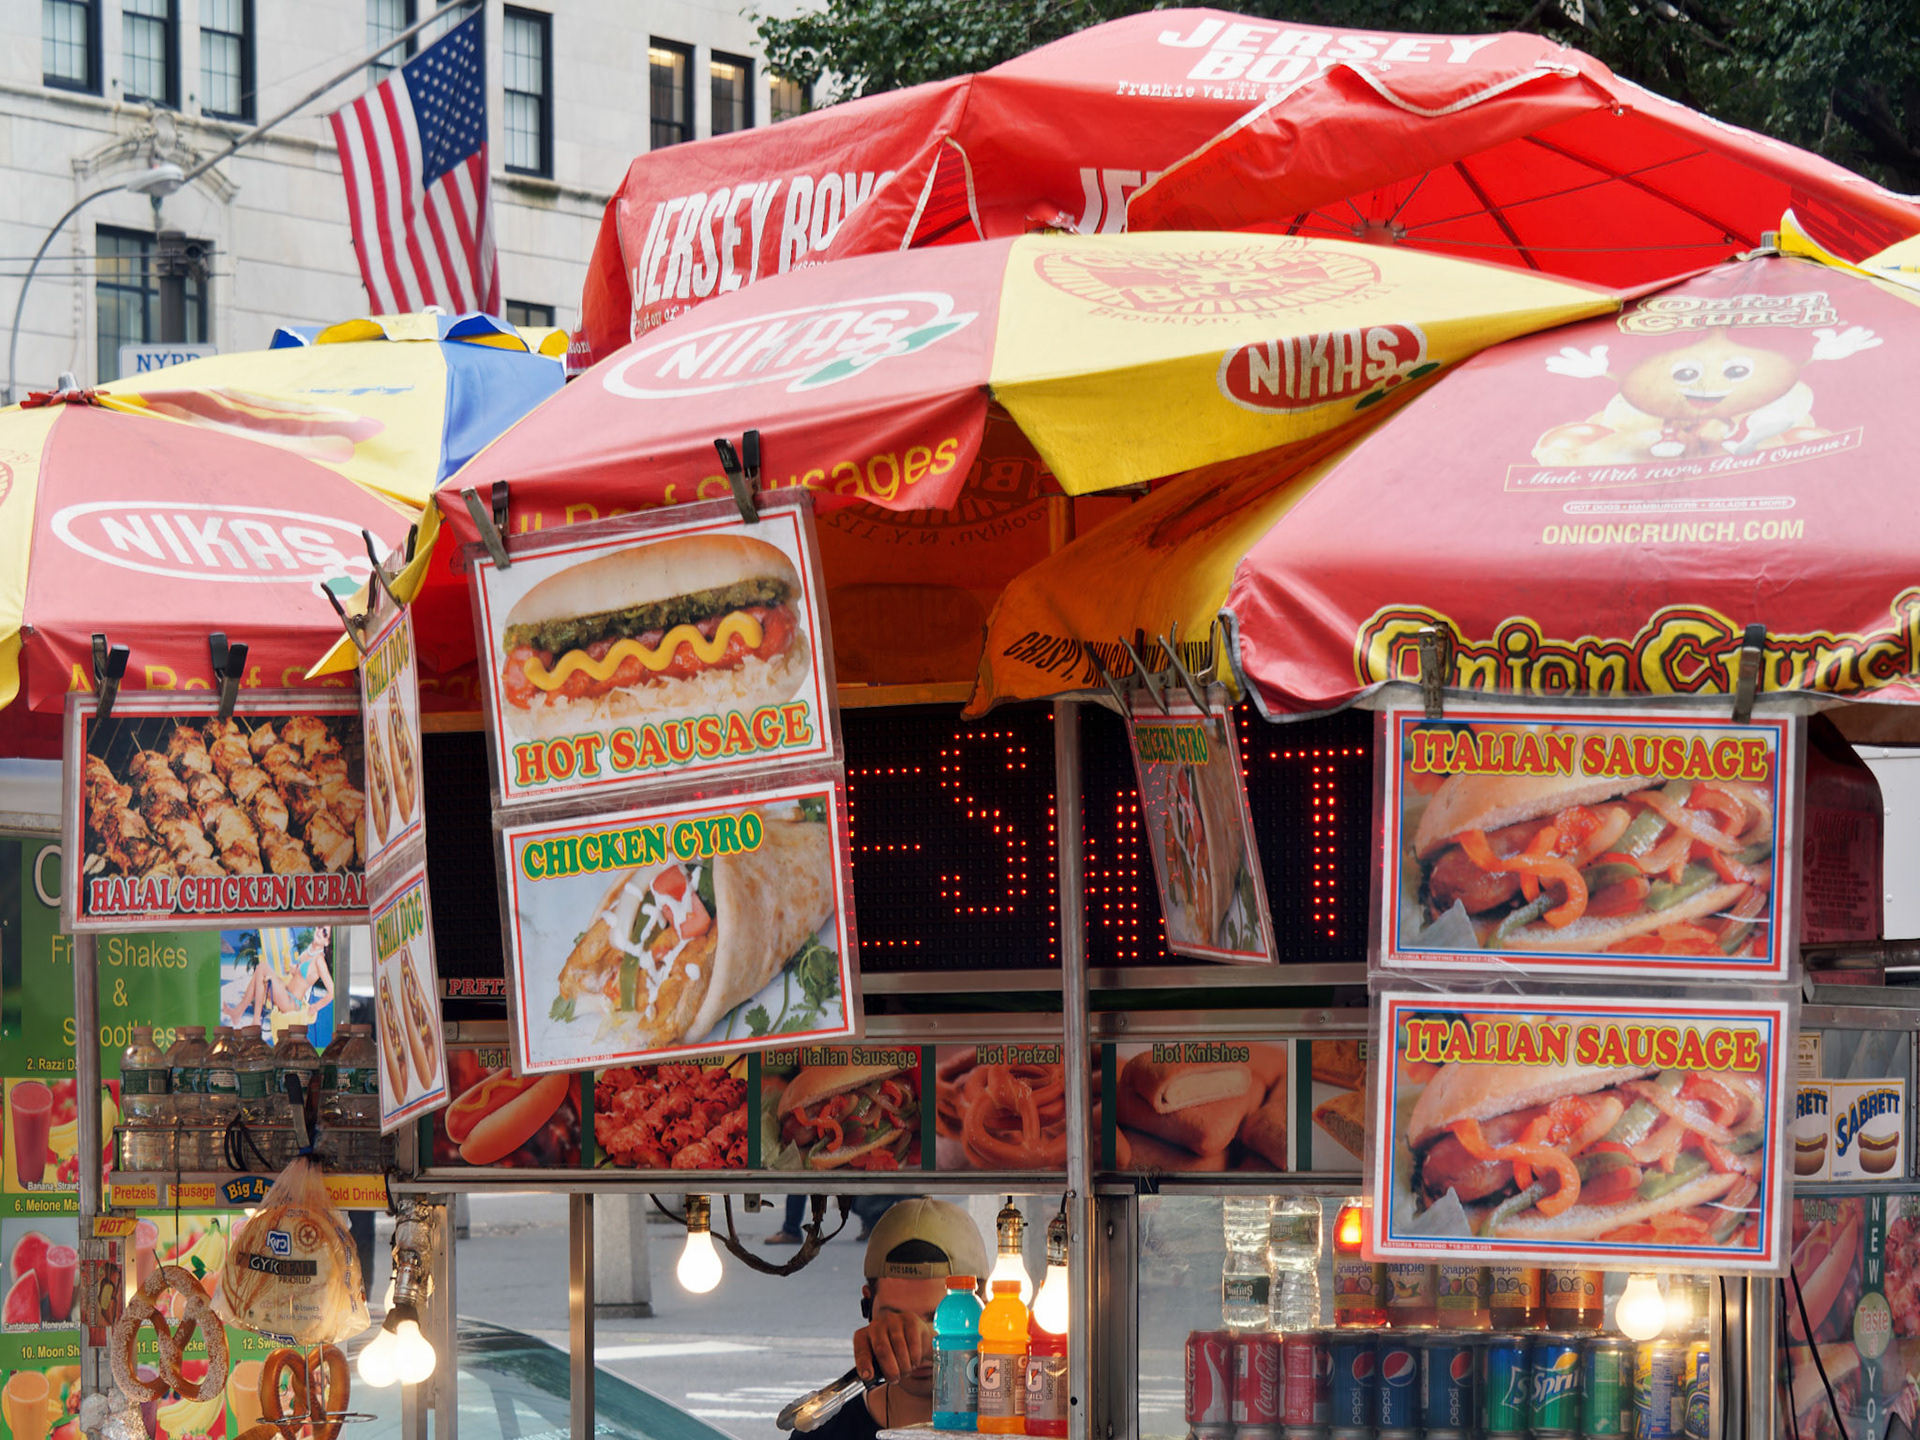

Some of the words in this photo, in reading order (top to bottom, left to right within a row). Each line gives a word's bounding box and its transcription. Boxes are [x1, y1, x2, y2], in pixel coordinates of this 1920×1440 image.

[1158, 17, 1501, 65] JERSEY
[1115, 80, 1195, 98] Frankie
[1203, 82, 1258, 100] Valli
[632, 178, 782, 312] JERSEY
[1616, 306, 1839, 335] Crunch
[654, 307, 910, 382] NIKAS
[1247, 325, 1400, 402] NIKAS
[1517, 471, 1582, 487] Made
[1588, 466, 1639, 483] With
[1645, 462, 1702, 481] 100%
[1708, 449, 1766, 472] Real
[98, 514, 337, 571] NIKAS
[1542, 518, 1805, 545] ONIONCRUNCH.COM
[514, 731, 604, 789] HOT
[609, 699, 814, 775] SAUSAGE
[1410, 729, 1577, 777] ITALIAN
[1580, 735, 1771, 782] SAUSAGE
[522, 821, 668, 881] CHICKEN
[670, 810, 764, 862] GYRO
[88, 876, 178, 916] HALAL
[177, 872, 292, 913] CHICKEN
[107, 937, 188, 969] Shakes
[112, 978, 129, 1007] &
[478, 1049, 503, 1068] Hot
[765, 1048, 799, 1067] Beef
[802, 1046, 849, 1066] Italian
[851, 1046, 918, 1069] Sausage
[976, 1046, 1004, 1065] Hot
[1007, 1045, 1061, 1065] Pretzel
[1152, 1043, 1181, 1063] Hot
[1184, 1042, 1250, 1063] Knishes
[1405, 1019, 1571, 1067] ITALIAN
[1575, 1022, 1761, 1073] SAUSAGE
[38, 1057, 65, 1071] Razzi
[1835, 1088, 1901, 1158] SABRETT
[114, 1186, 157, 1200] Pretzels
[170, 1183, 216, 1200] Sausage
[227, 1180, 251, 1200] Big
[353, 1187, 388, 1201] Drinks
[26, 1200, 61, 1213] Melone
[98, 1220, 126, 1233] HOT
[1382, 1241, 1413, 1249] ASTORIA
[1413, 1242, 1447, 1250] PRINTING
[1859, 1306, 1889, 1335] Taste
[21, 1345, 35, 1359] 10.
[38, 1345, 66, 1358] Moon
[242, 1338, 256, 1350] 12.
[979, 1359, 1000, 1390] G
[1352, 1387, 1363, 1425] pepsi
[1381, 1387, 1392, 1425] pepsi
[1450, 1387, 1460, 1426] pepsi
